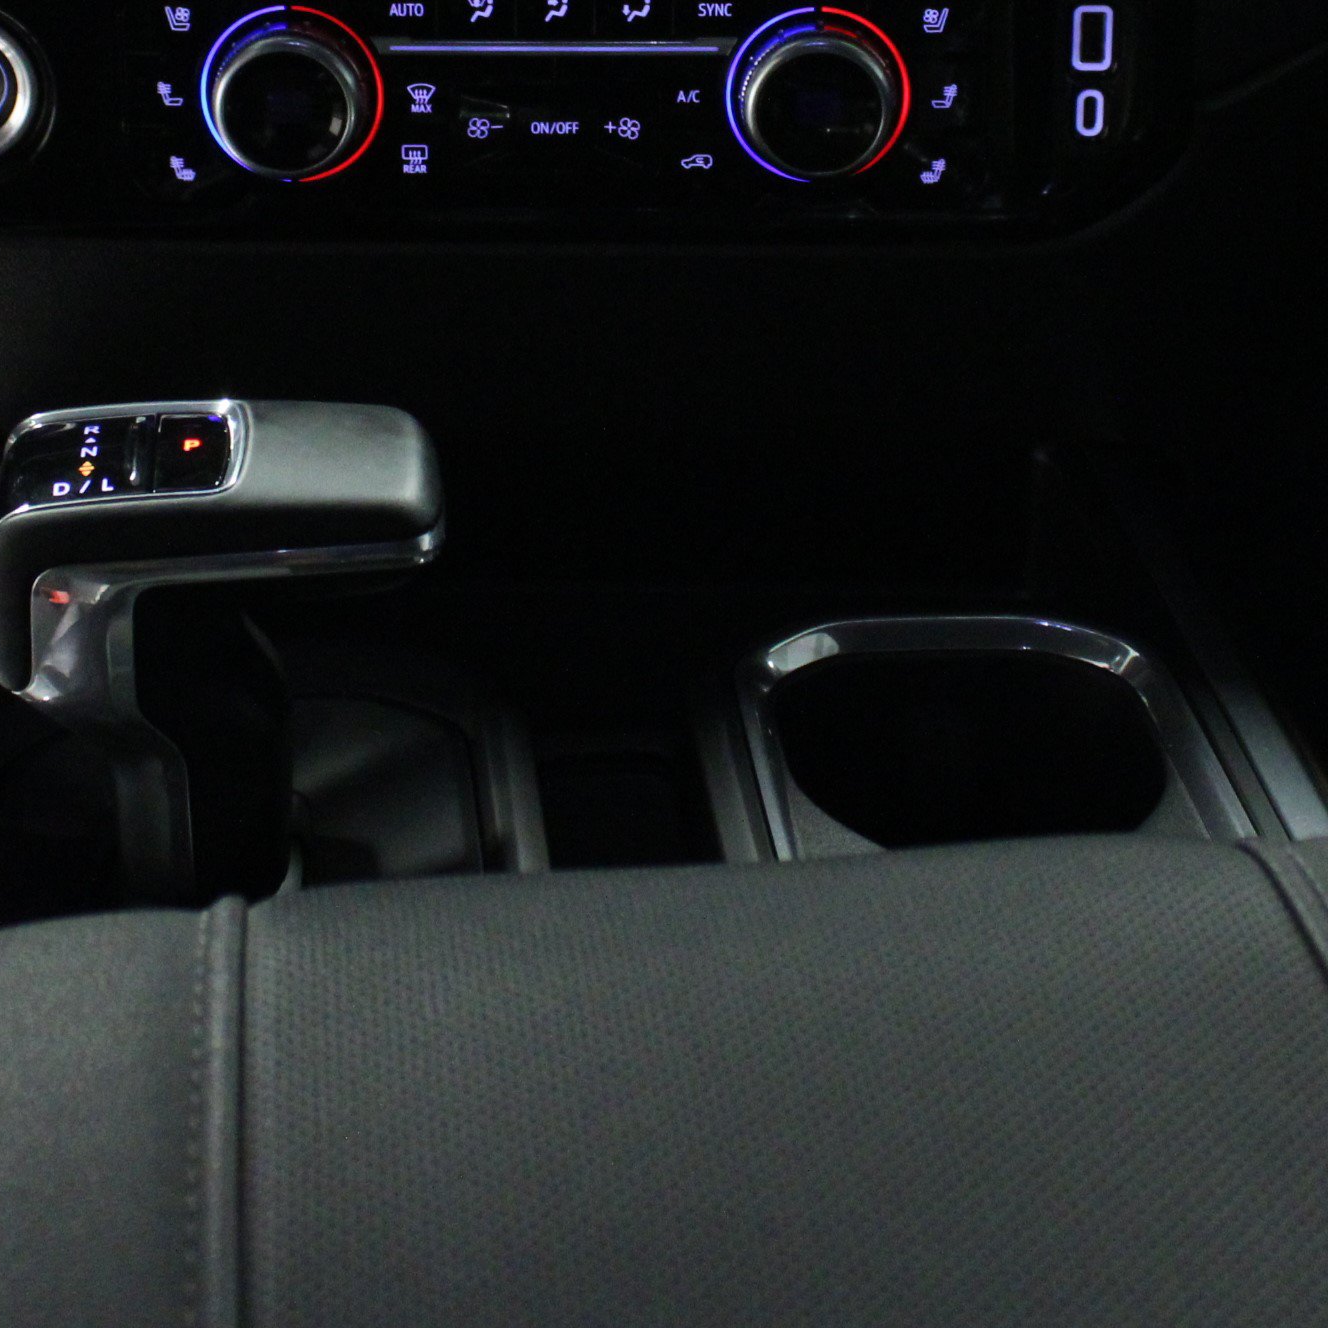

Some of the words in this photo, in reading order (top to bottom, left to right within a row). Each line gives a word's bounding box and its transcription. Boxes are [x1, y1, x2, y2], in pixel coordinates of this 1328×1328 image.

[388, 2, 425, 18] AUTO
[697, 2, 734, 18] SYNC
[676, 89, 701, 104] A/C
[410, 104, 433, 113] MAX
[530, 121, 580, 135] ON/OFF
[402, 164, 428, 174] REAR
[83, 425, 101, 435] R
[80, 445, 99, 458] N
[182, 437, 203, 452] P
